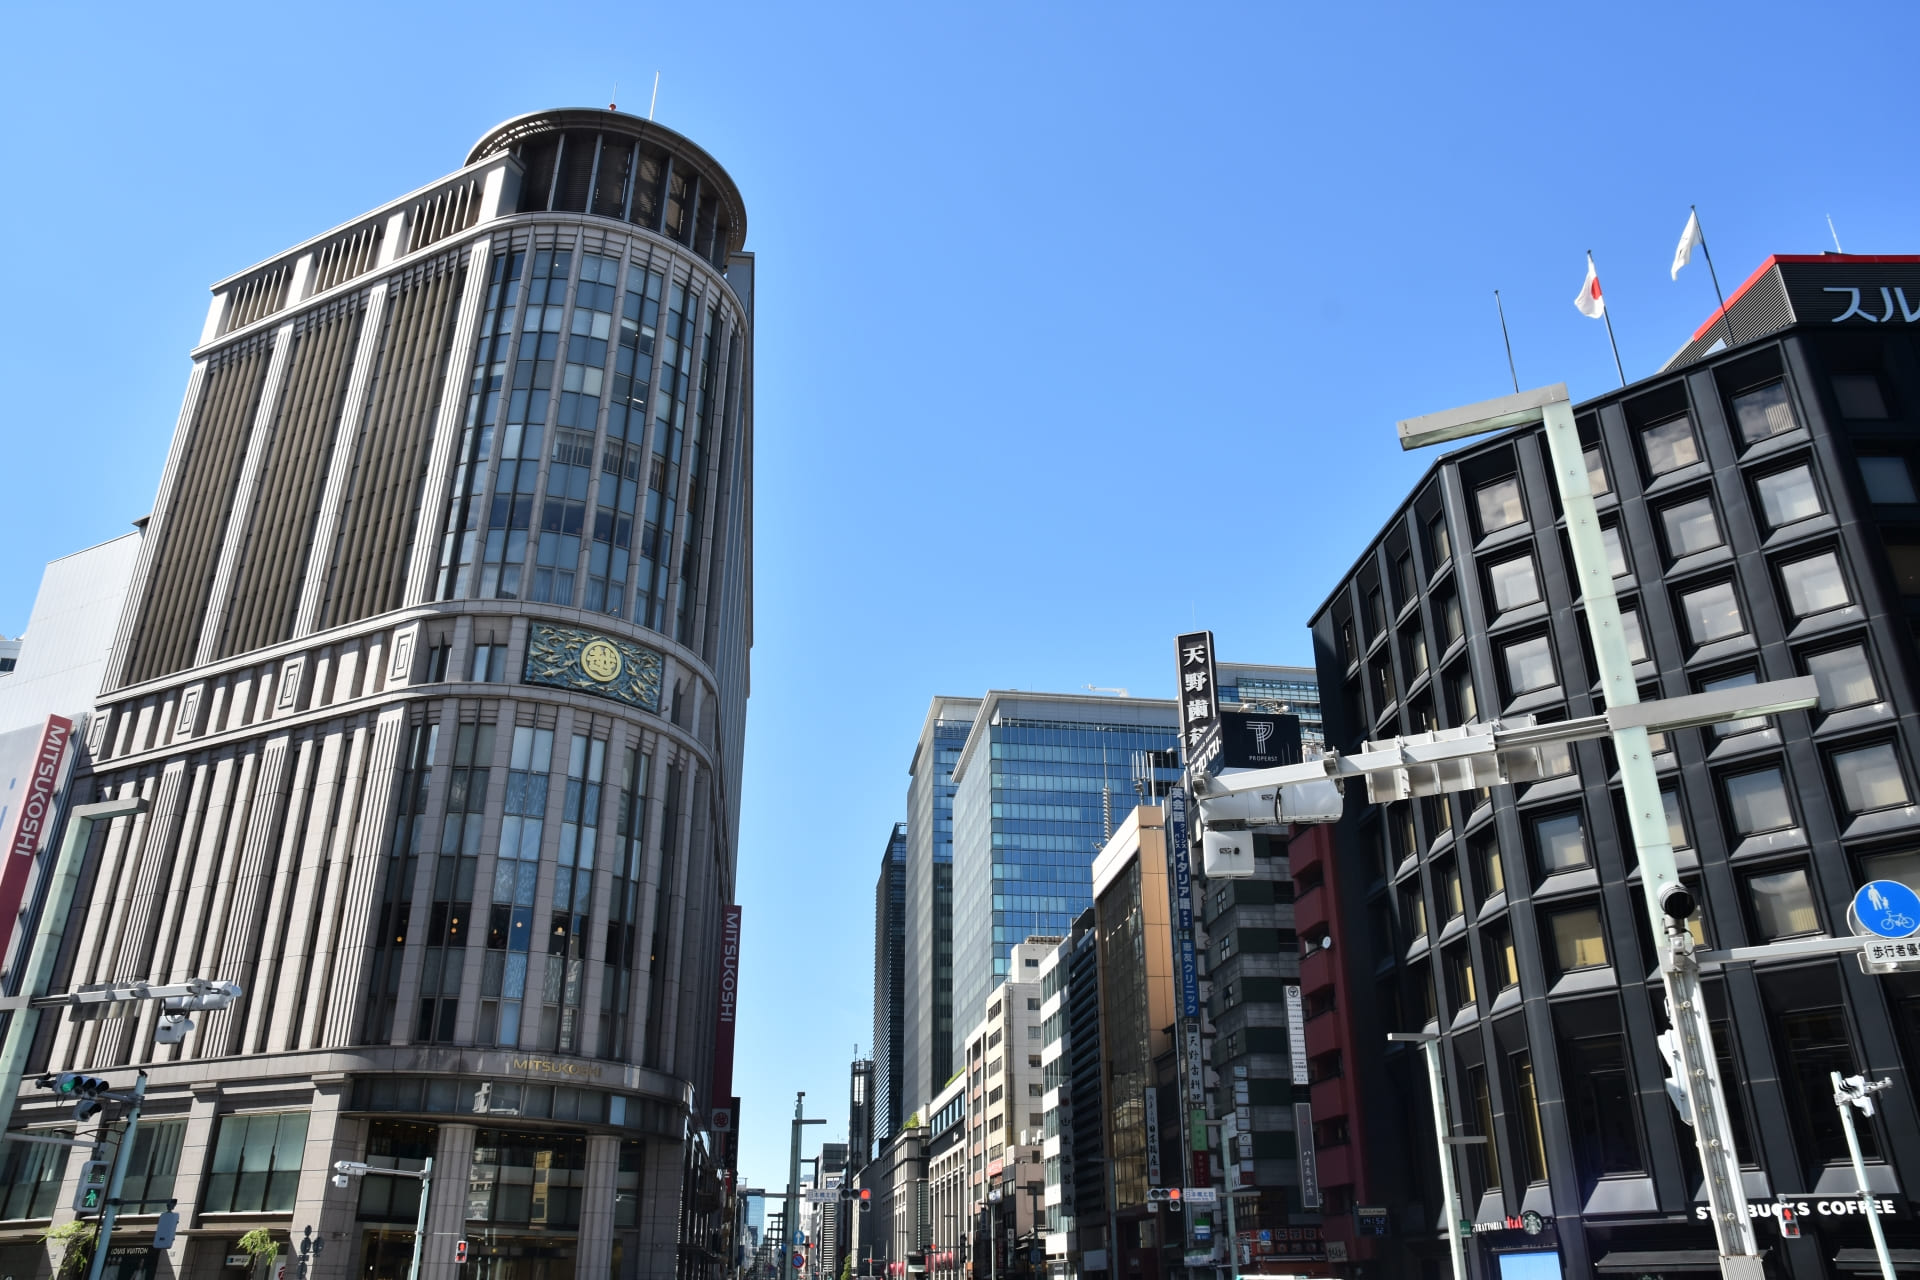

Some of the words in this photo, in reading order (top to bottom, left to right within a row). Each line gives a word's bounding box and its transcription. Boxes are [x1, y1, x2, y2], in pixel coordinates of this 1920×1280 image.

[15, 724, 67, 857] MITSUKOSHI
[1873, 942, 1920, 959] 歩行者優
[720, 912, 739, 1022] MITSUKOSHI
[513, 1058, 602, 1078] MITSUKOSHI
[1696, 1202, 1810, 1220] STBUCS
